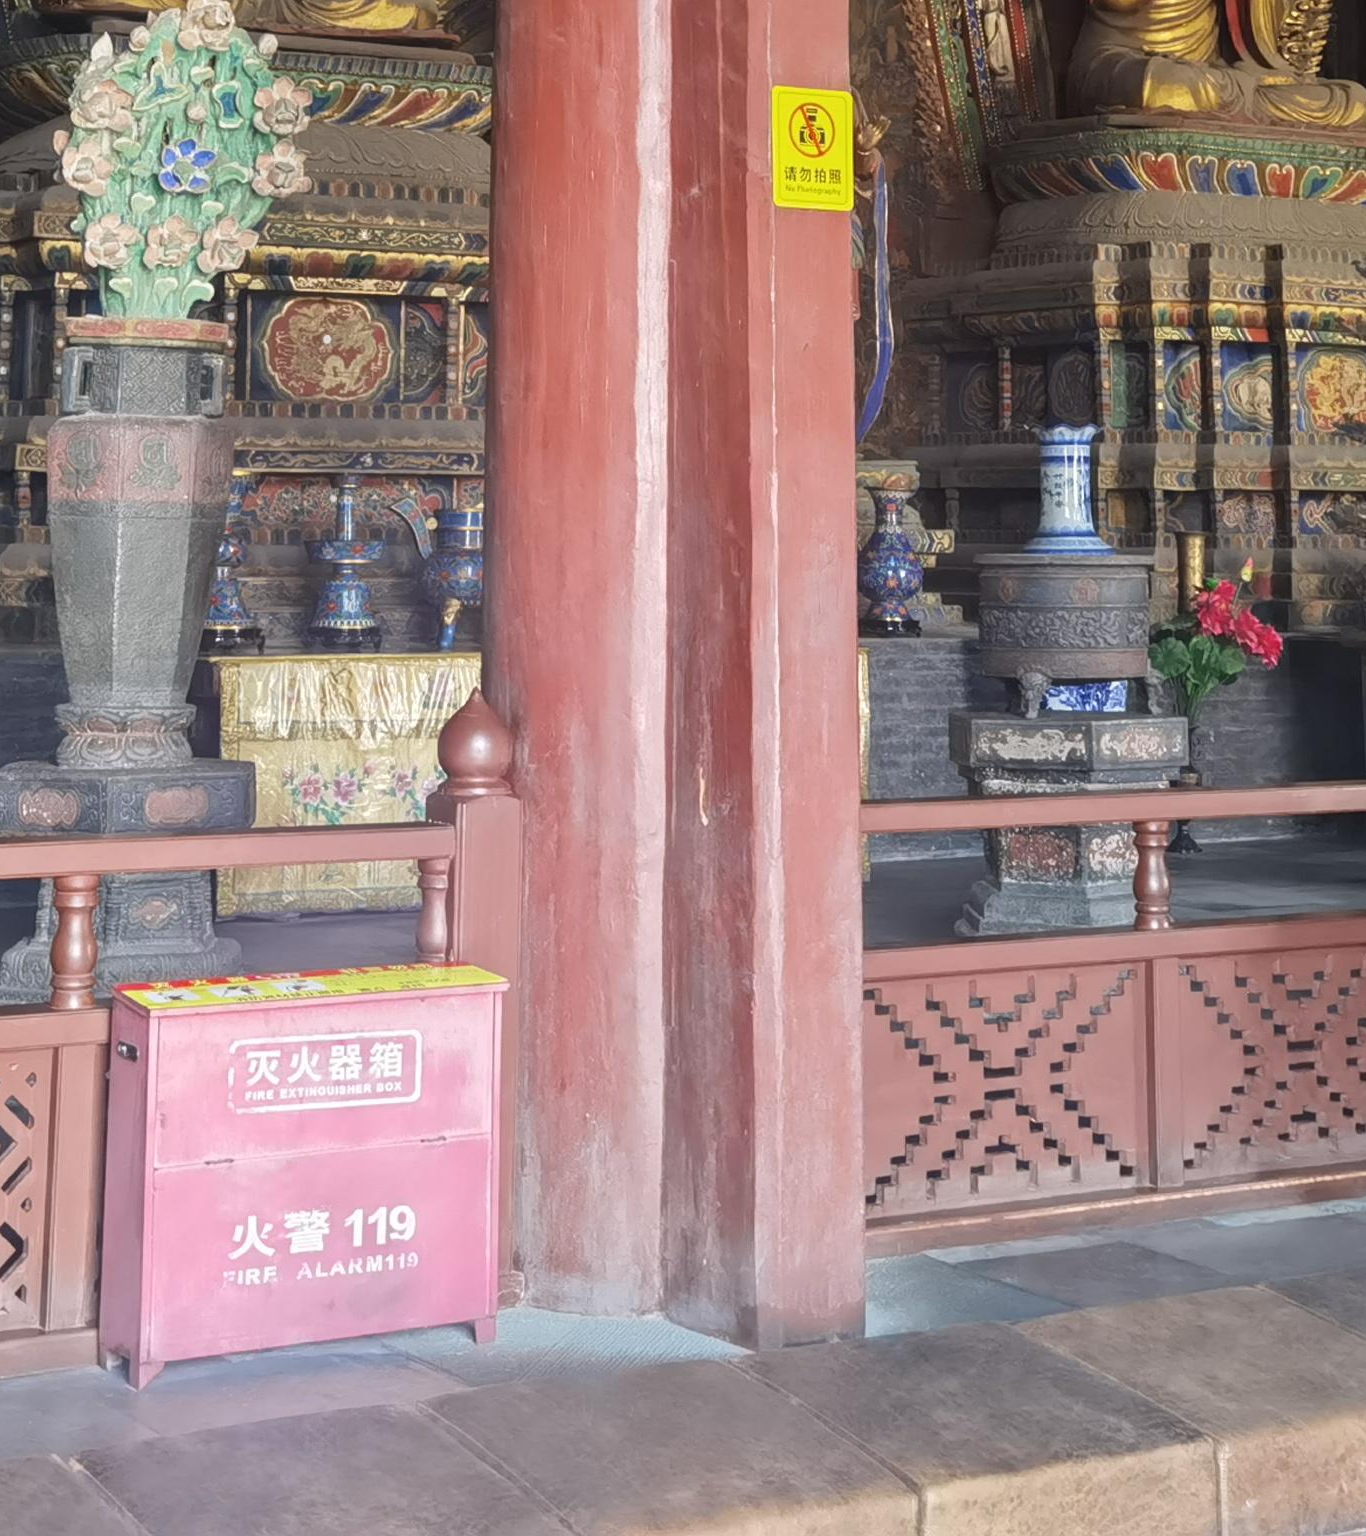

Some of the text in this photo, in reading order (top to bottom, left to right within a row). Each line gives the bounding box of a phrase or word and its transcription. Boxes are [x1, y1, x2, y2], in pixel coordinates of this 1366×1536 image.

[784, 166, 841, 184] 请勿拍照
[246, 1041, 404, 1086] 灭火器箱
[245, 1081, 403, 1101] FIRE EXTINGUISHER BOX
